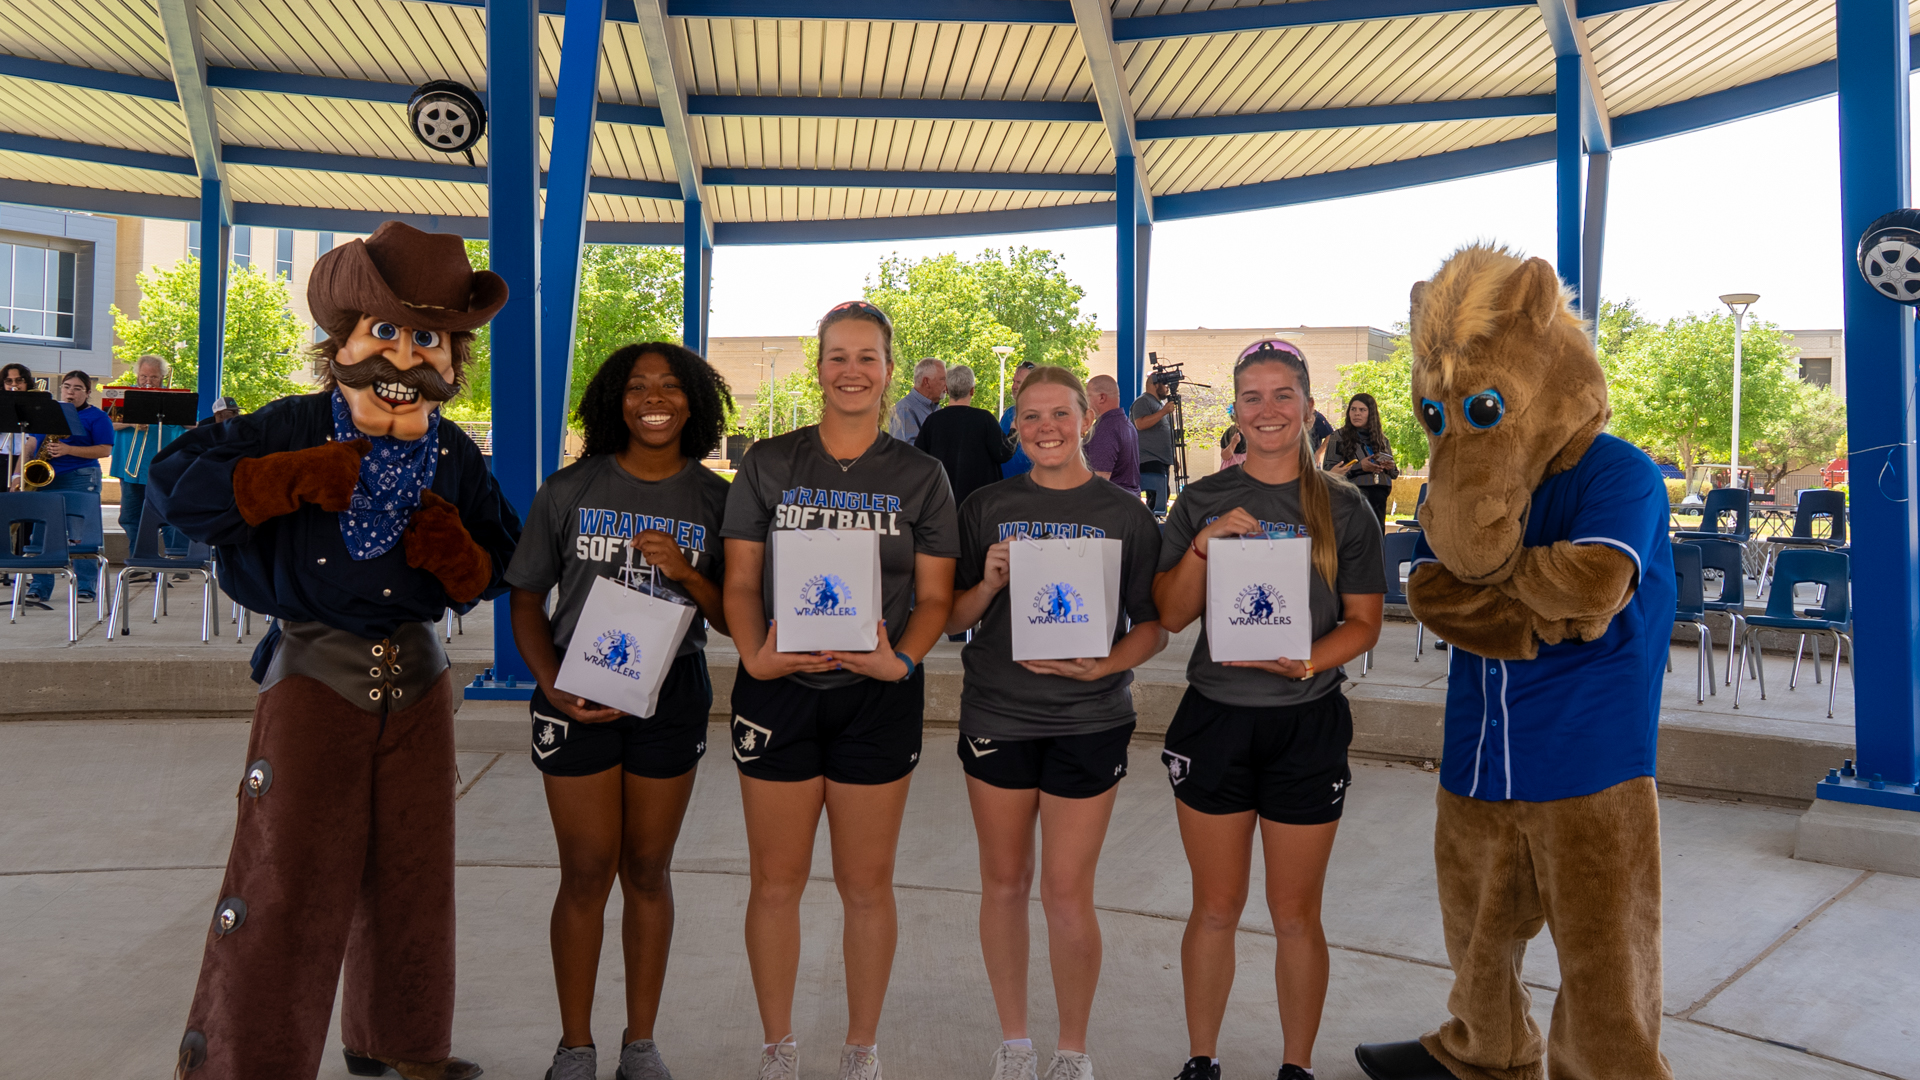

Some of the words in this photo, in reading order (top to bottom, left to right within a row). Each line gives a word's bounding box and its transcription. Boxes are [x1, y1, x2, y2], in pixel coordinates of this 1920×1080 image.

[782, 486, 902, 512] WRANGLER
[776, 504, 900, 535] SOFTBALL
[1206, 516, 1308, 536] NGLE
[998, 521, 1105, 542] WRANGLER
[577, 535, 699, 568] SOFT
[1234, 583, 1258, 610] ODESSA
[1261, 582, 1287, 609] COLLEGE
[793, 607, 857, 616] WRANGLERS
[1027, 613, 1090, 625] WRANGLERS
[1228, 616, 1292, 625] WRANGLERS
[593, 629, 622, 648] ODESSA
[584, 651, 641, 680] WRANGLERS
